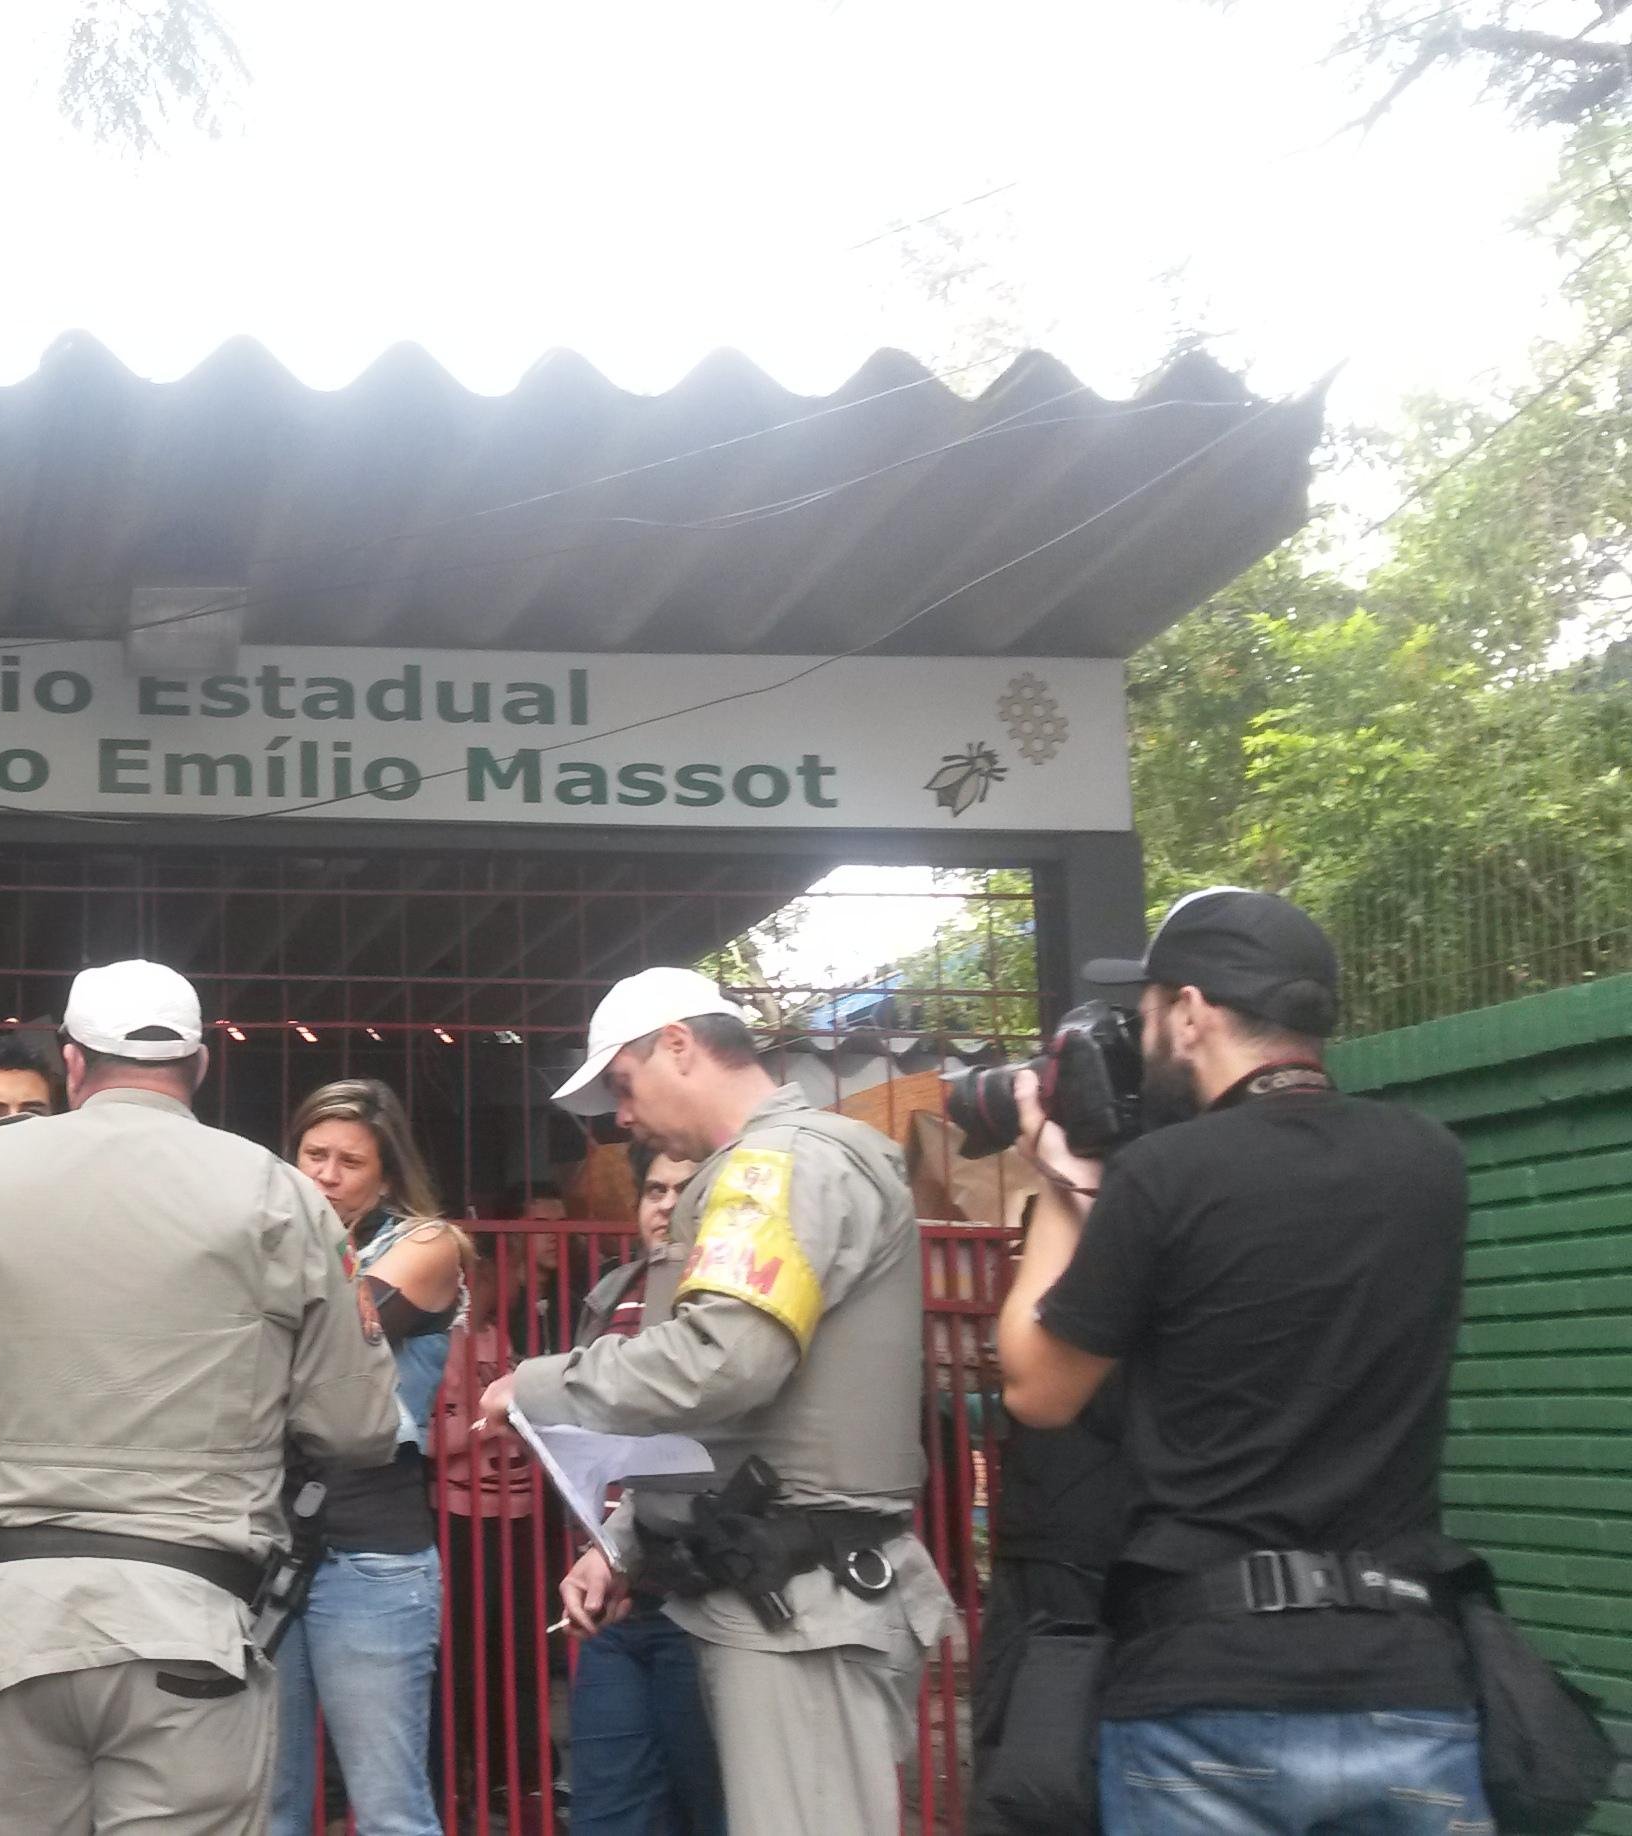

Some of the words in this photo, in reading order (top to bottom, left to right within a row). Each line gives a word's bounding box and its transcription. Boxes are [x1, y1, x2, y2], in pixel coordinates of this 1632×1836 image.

[138, 664, 589, 726] Estadual
[97, 736, 421, 802] Emílio
[466, 746, 839, 809] Massot
